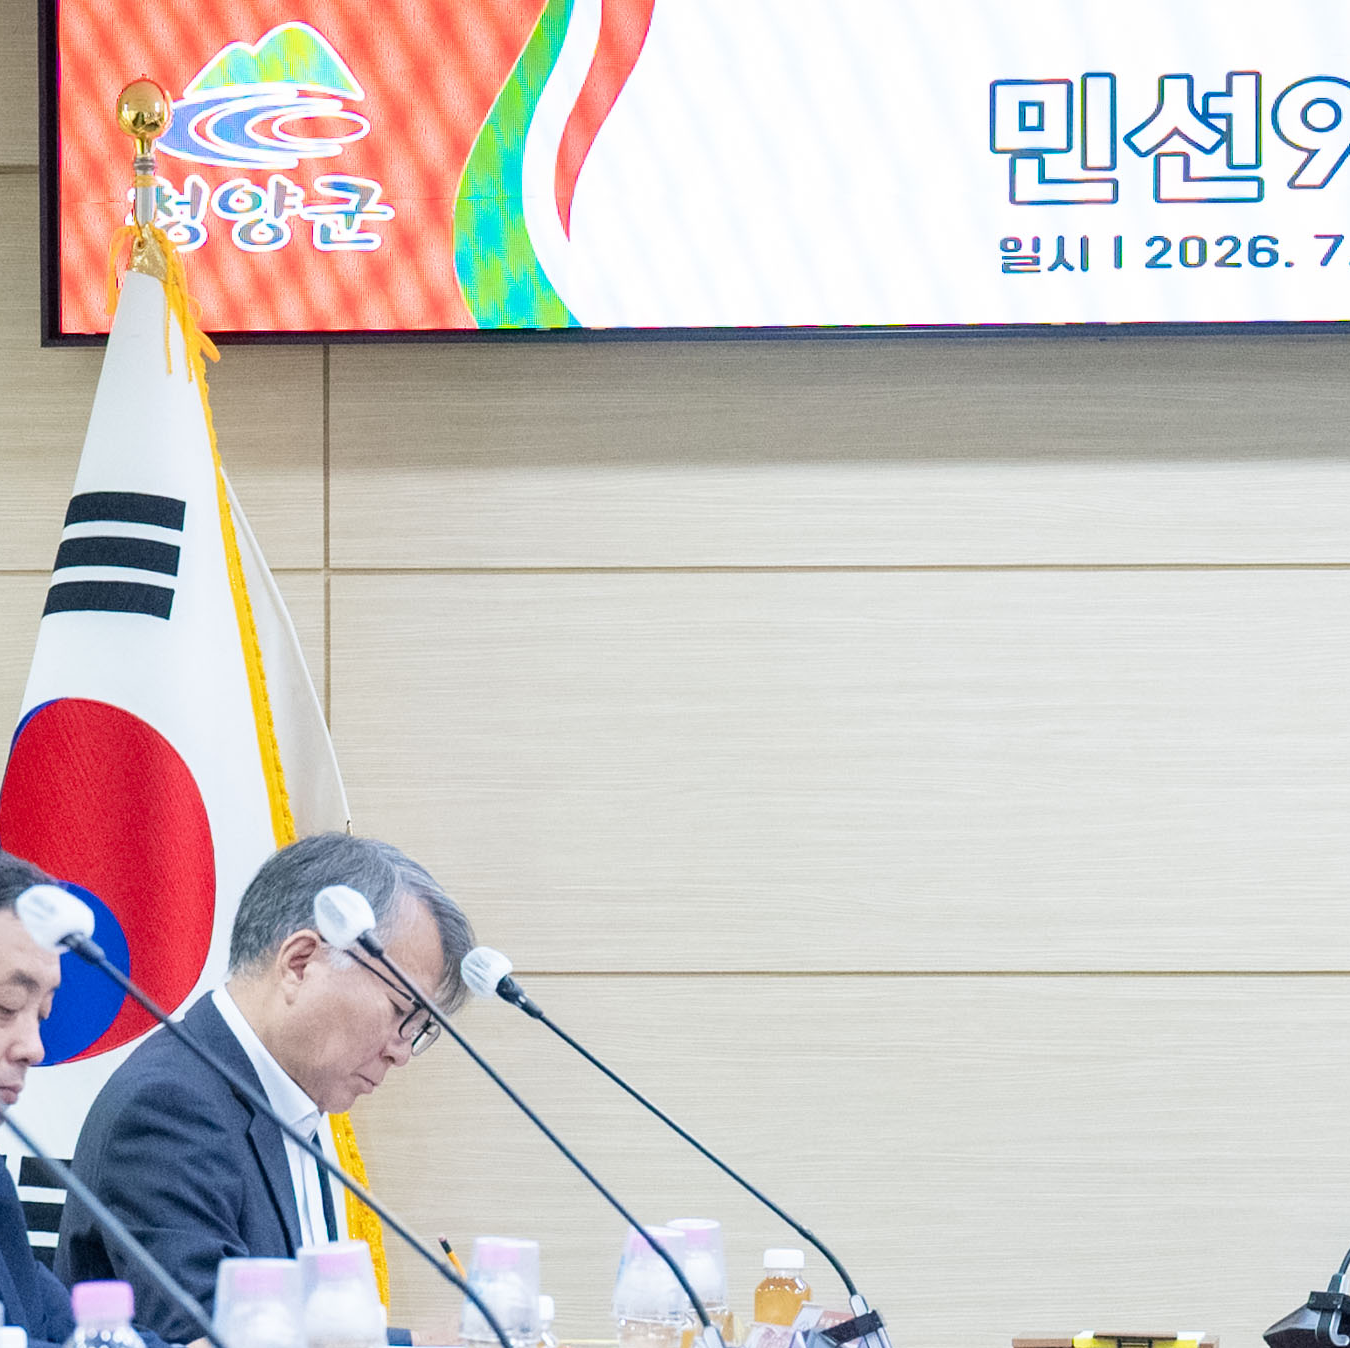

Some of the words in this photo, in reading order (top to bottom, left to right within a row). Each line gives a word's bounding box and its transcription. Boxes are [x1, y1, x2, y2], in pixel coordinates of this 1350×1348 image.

[126, 173, 395, 253] 청양군
[999, 235, 1090, 275] 일시
[1144, 234, 1295, 270] 2026.
